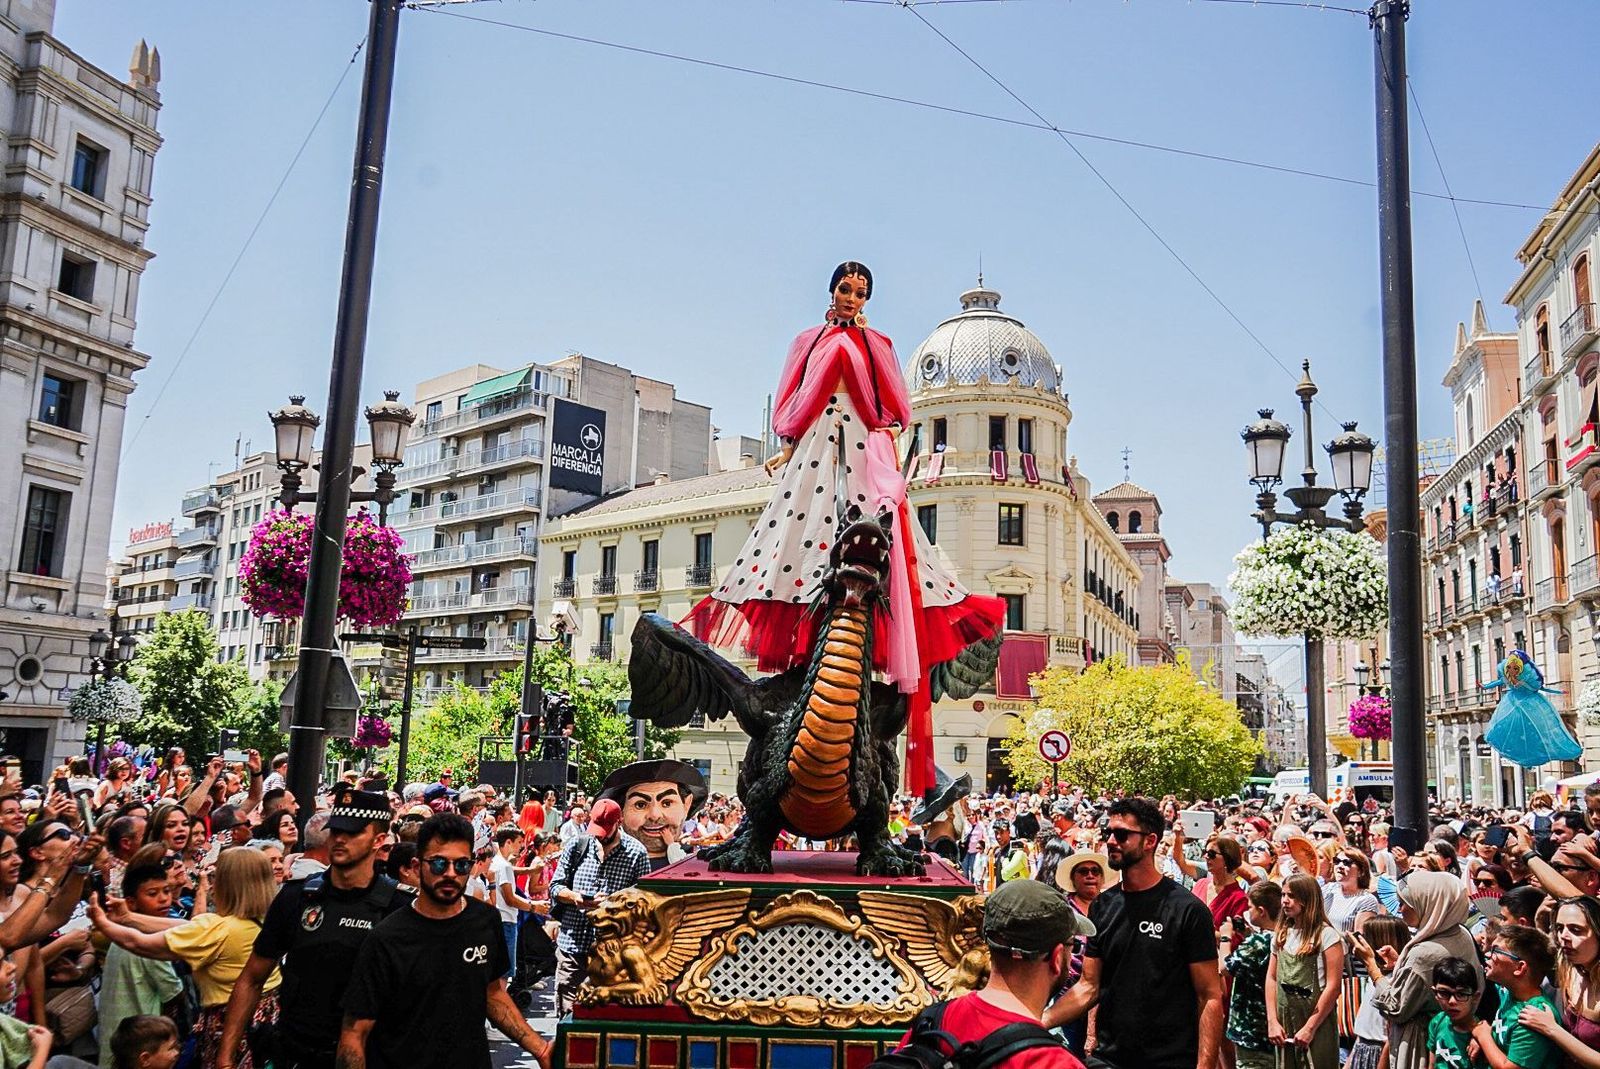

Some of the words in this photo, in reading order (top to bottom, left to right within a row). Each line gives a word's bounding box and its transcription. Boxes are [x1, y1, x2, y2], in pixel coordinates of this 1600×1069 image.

[552, 442, 589, 463] MARCA
[590, 451, 602, 466] LA
[551, 455, 602, 477] DIFERENCIA
[339, 917, 373, 929] POLICIA
[1139, 921, 1163, 935] CAO
[463, 945, 487, 962] CAO
